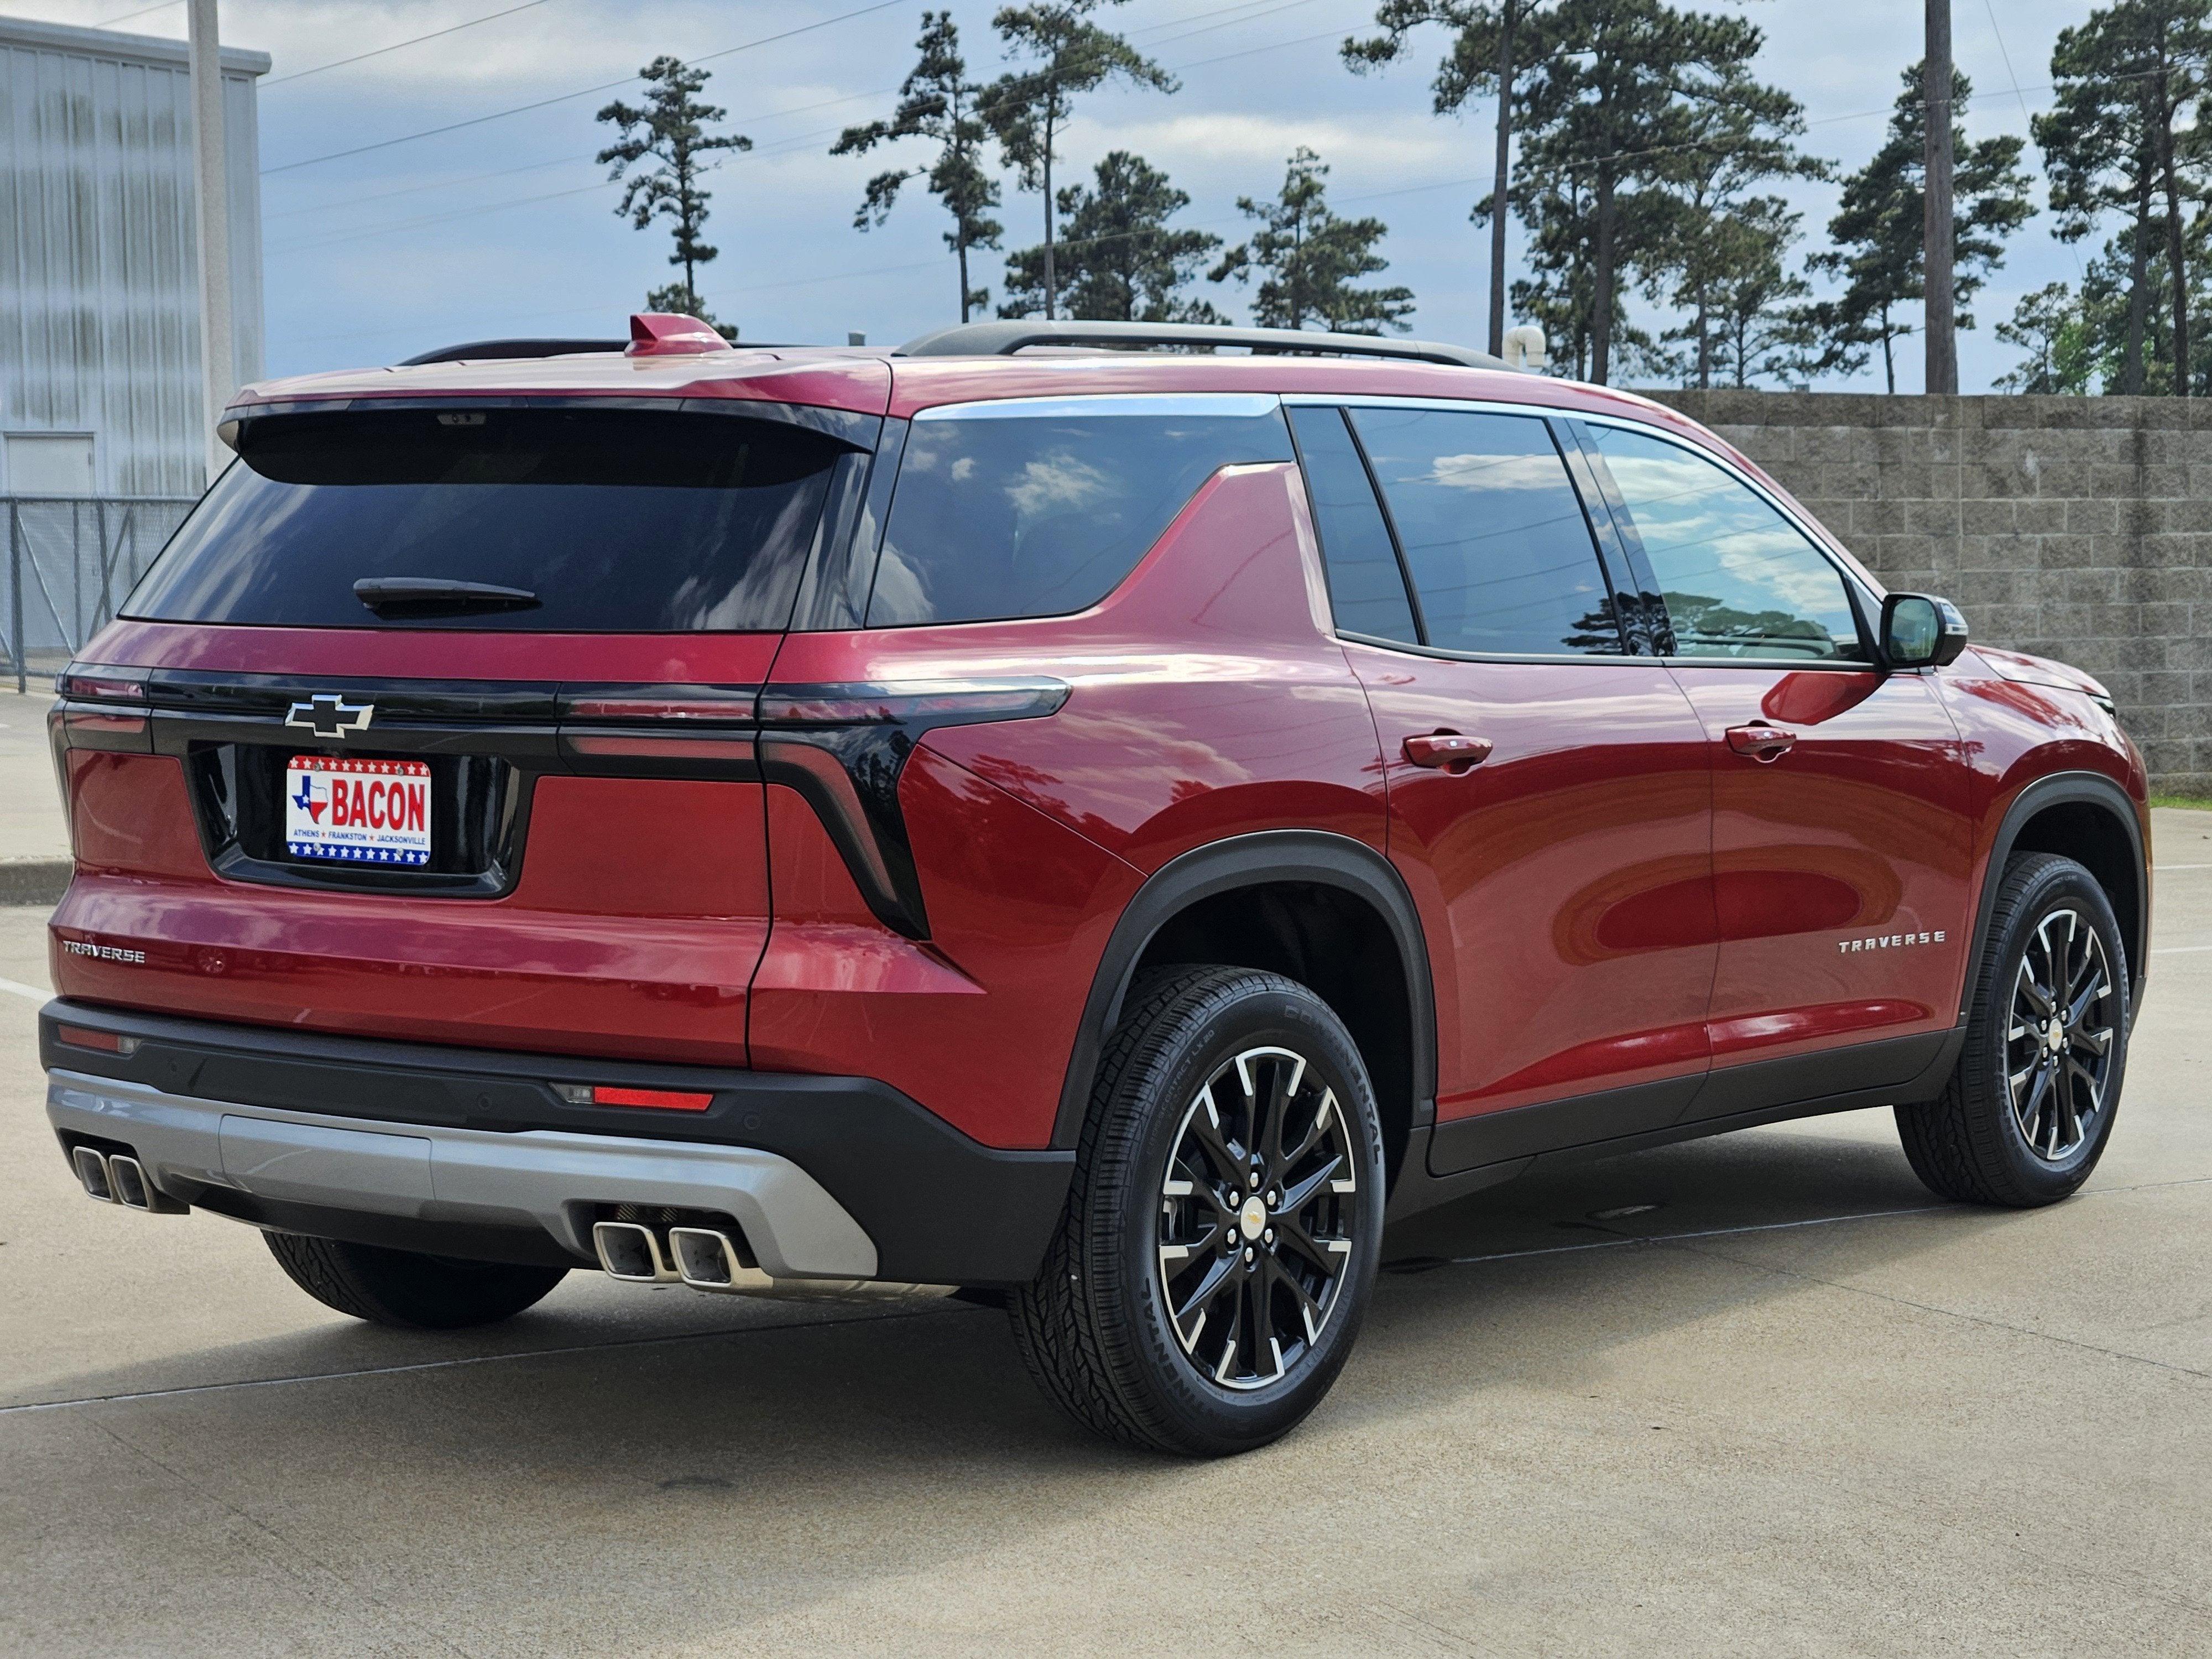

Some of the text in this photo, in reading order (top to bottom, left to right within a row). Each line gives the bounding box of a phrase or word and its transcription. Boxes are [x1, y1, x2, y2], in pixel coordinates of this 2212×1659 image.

[332, 779, 425, 832] BACON
[294, 828, 426, 845] ATHENS FRANKSTON JACKSONVILLE
[63, 940, 145, 963] TRAVERSE
[1838, 931, 1945, 953] TRAVERSE
[1191, 1040, 1204, 1057] LX
[1202, 1029, 1215, 1044] 20
